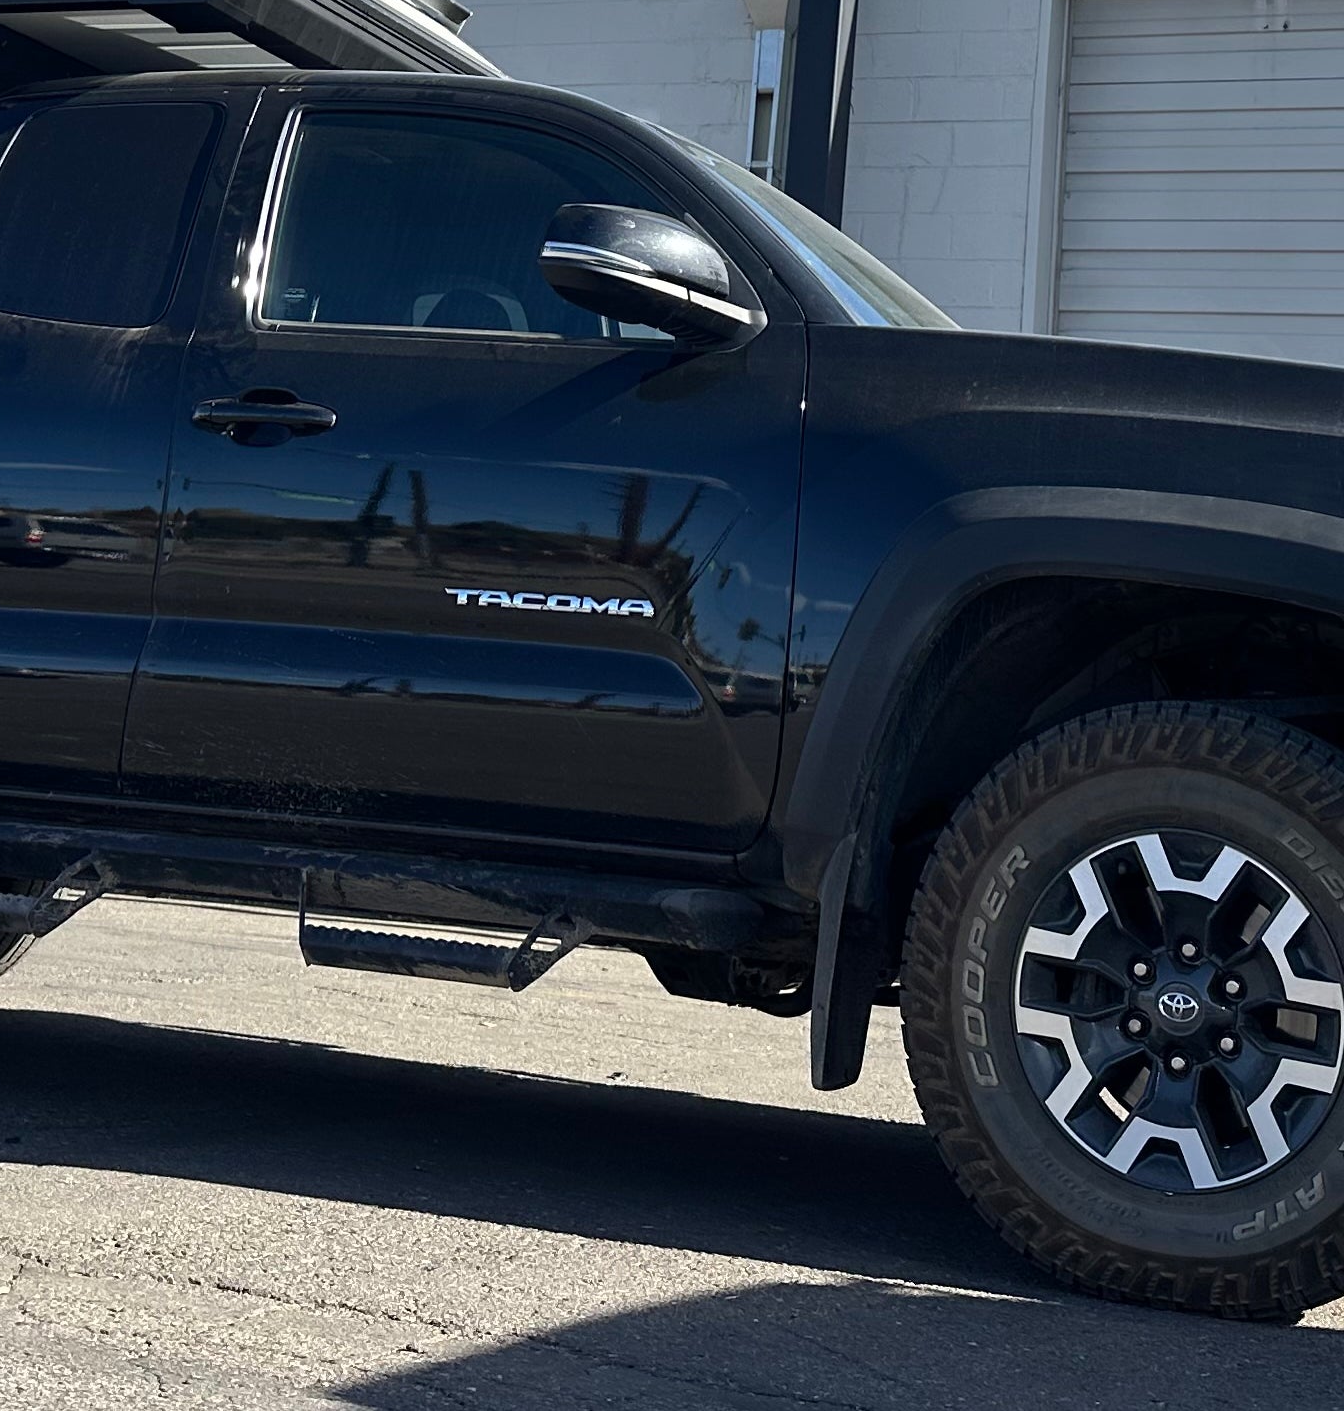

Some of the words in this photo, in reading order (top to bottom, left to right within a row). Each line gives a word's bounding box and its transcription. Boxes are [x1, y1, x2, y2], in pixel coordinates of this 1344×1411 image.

[444, 587, 655, 618] TACOMA
[962, 845, 1031, 1087] COOPER
[1232, 1171, 1326, 1241] ATP
